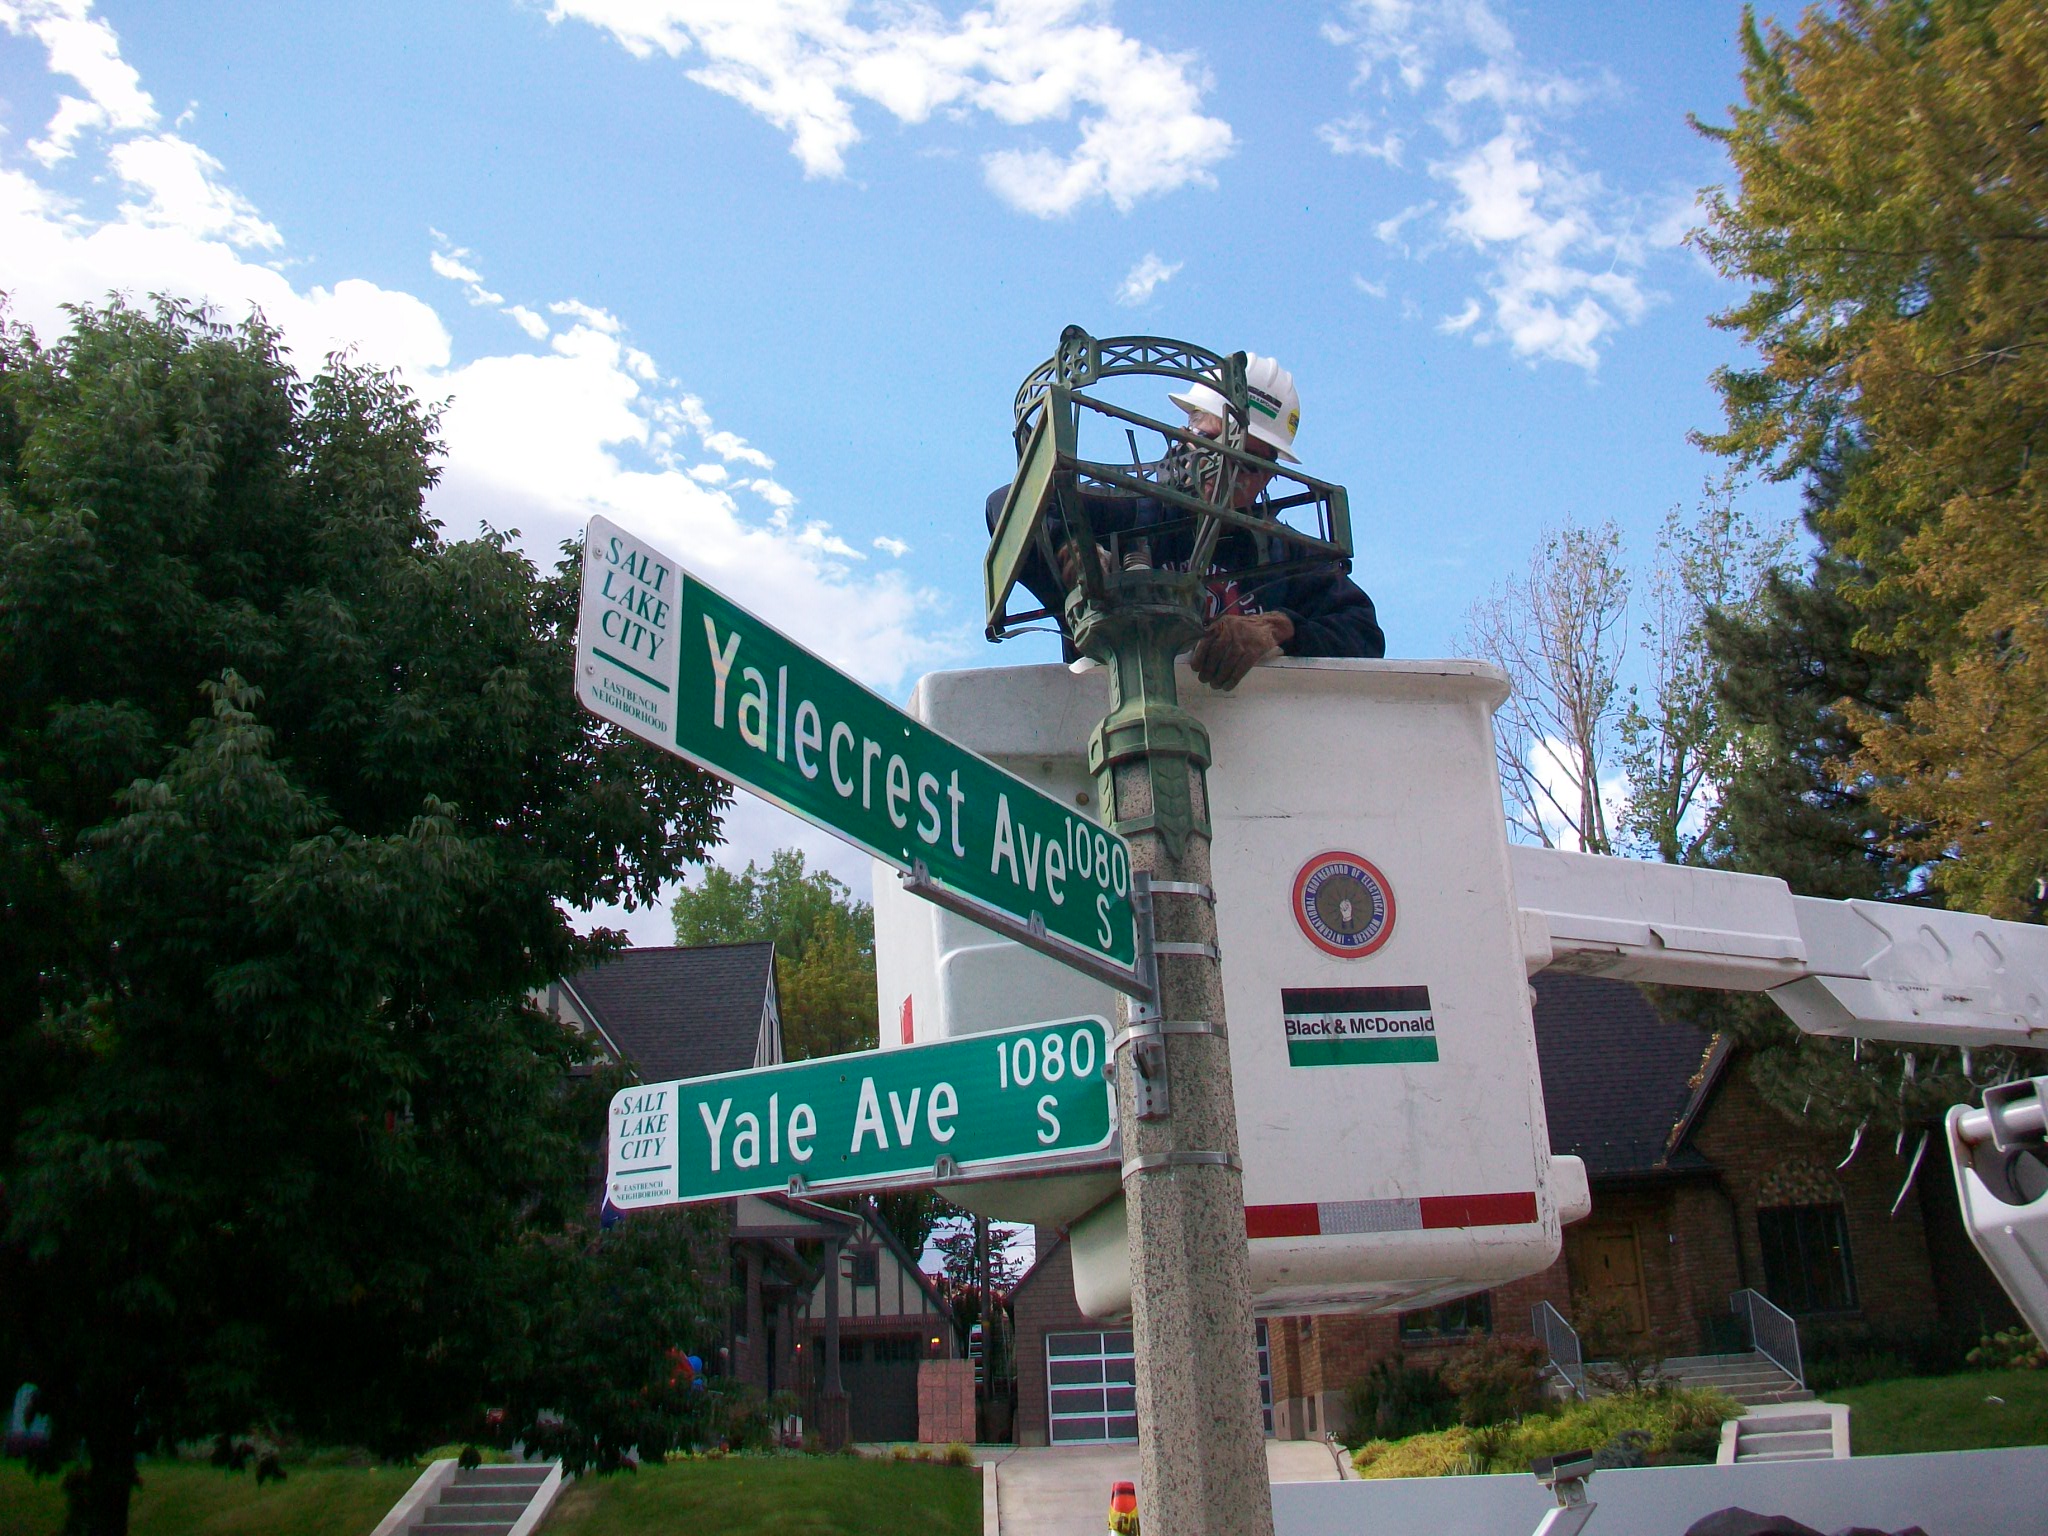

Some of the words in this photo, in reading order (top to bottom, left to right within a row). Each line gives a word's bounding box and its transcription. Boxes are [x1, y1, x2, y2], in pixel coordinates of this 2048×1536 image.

[606, 537, 669, 593] SALT
[601, 570, 670, 629] LAKE
[602, 610, 665, 661] CITY
[592, 685, 667, 732] NEIGHBORHOOD
[604, 677, 658, 714] EASTBENCH
[703, 613, 965, 858] Yalecrest
[991, 792, 1066, 905] Ave
[1065, 816, 1127, 898] 1080
[1307, 865, 1348, 893] BROTHERHOOD
[1351, 867, 1361, 878] OF
[1361, 874, 1383, 916] ELECTRICAL
[1096, 893, 1113, 949] S
[1305, 897, 1345, 944] INTERNATIONAL
[1353, 918, 1381, 944] WORKERS
[1285, 1019, 1331, 1036] Black
[1334, 1018, 1347, 1034] &
[1350, 1016, 1435, 1034] McDonald
[997, 1028, 1095, 1088] 1080
[620, 1091, 667, 1115] SALT
[698, 1092, 817, 1172] Yale
[850, 1076, 959, 1154] Ave
[1037, 1095, 1061, 1144] S
[620, 1113, 668, 1138] LAKE
[621, 1137, 666, 1160] CITY
[616, 1189, 671, 1200] NEIGHBORHOOD
[623, 1181, 663, 1192] EASTBENCH
